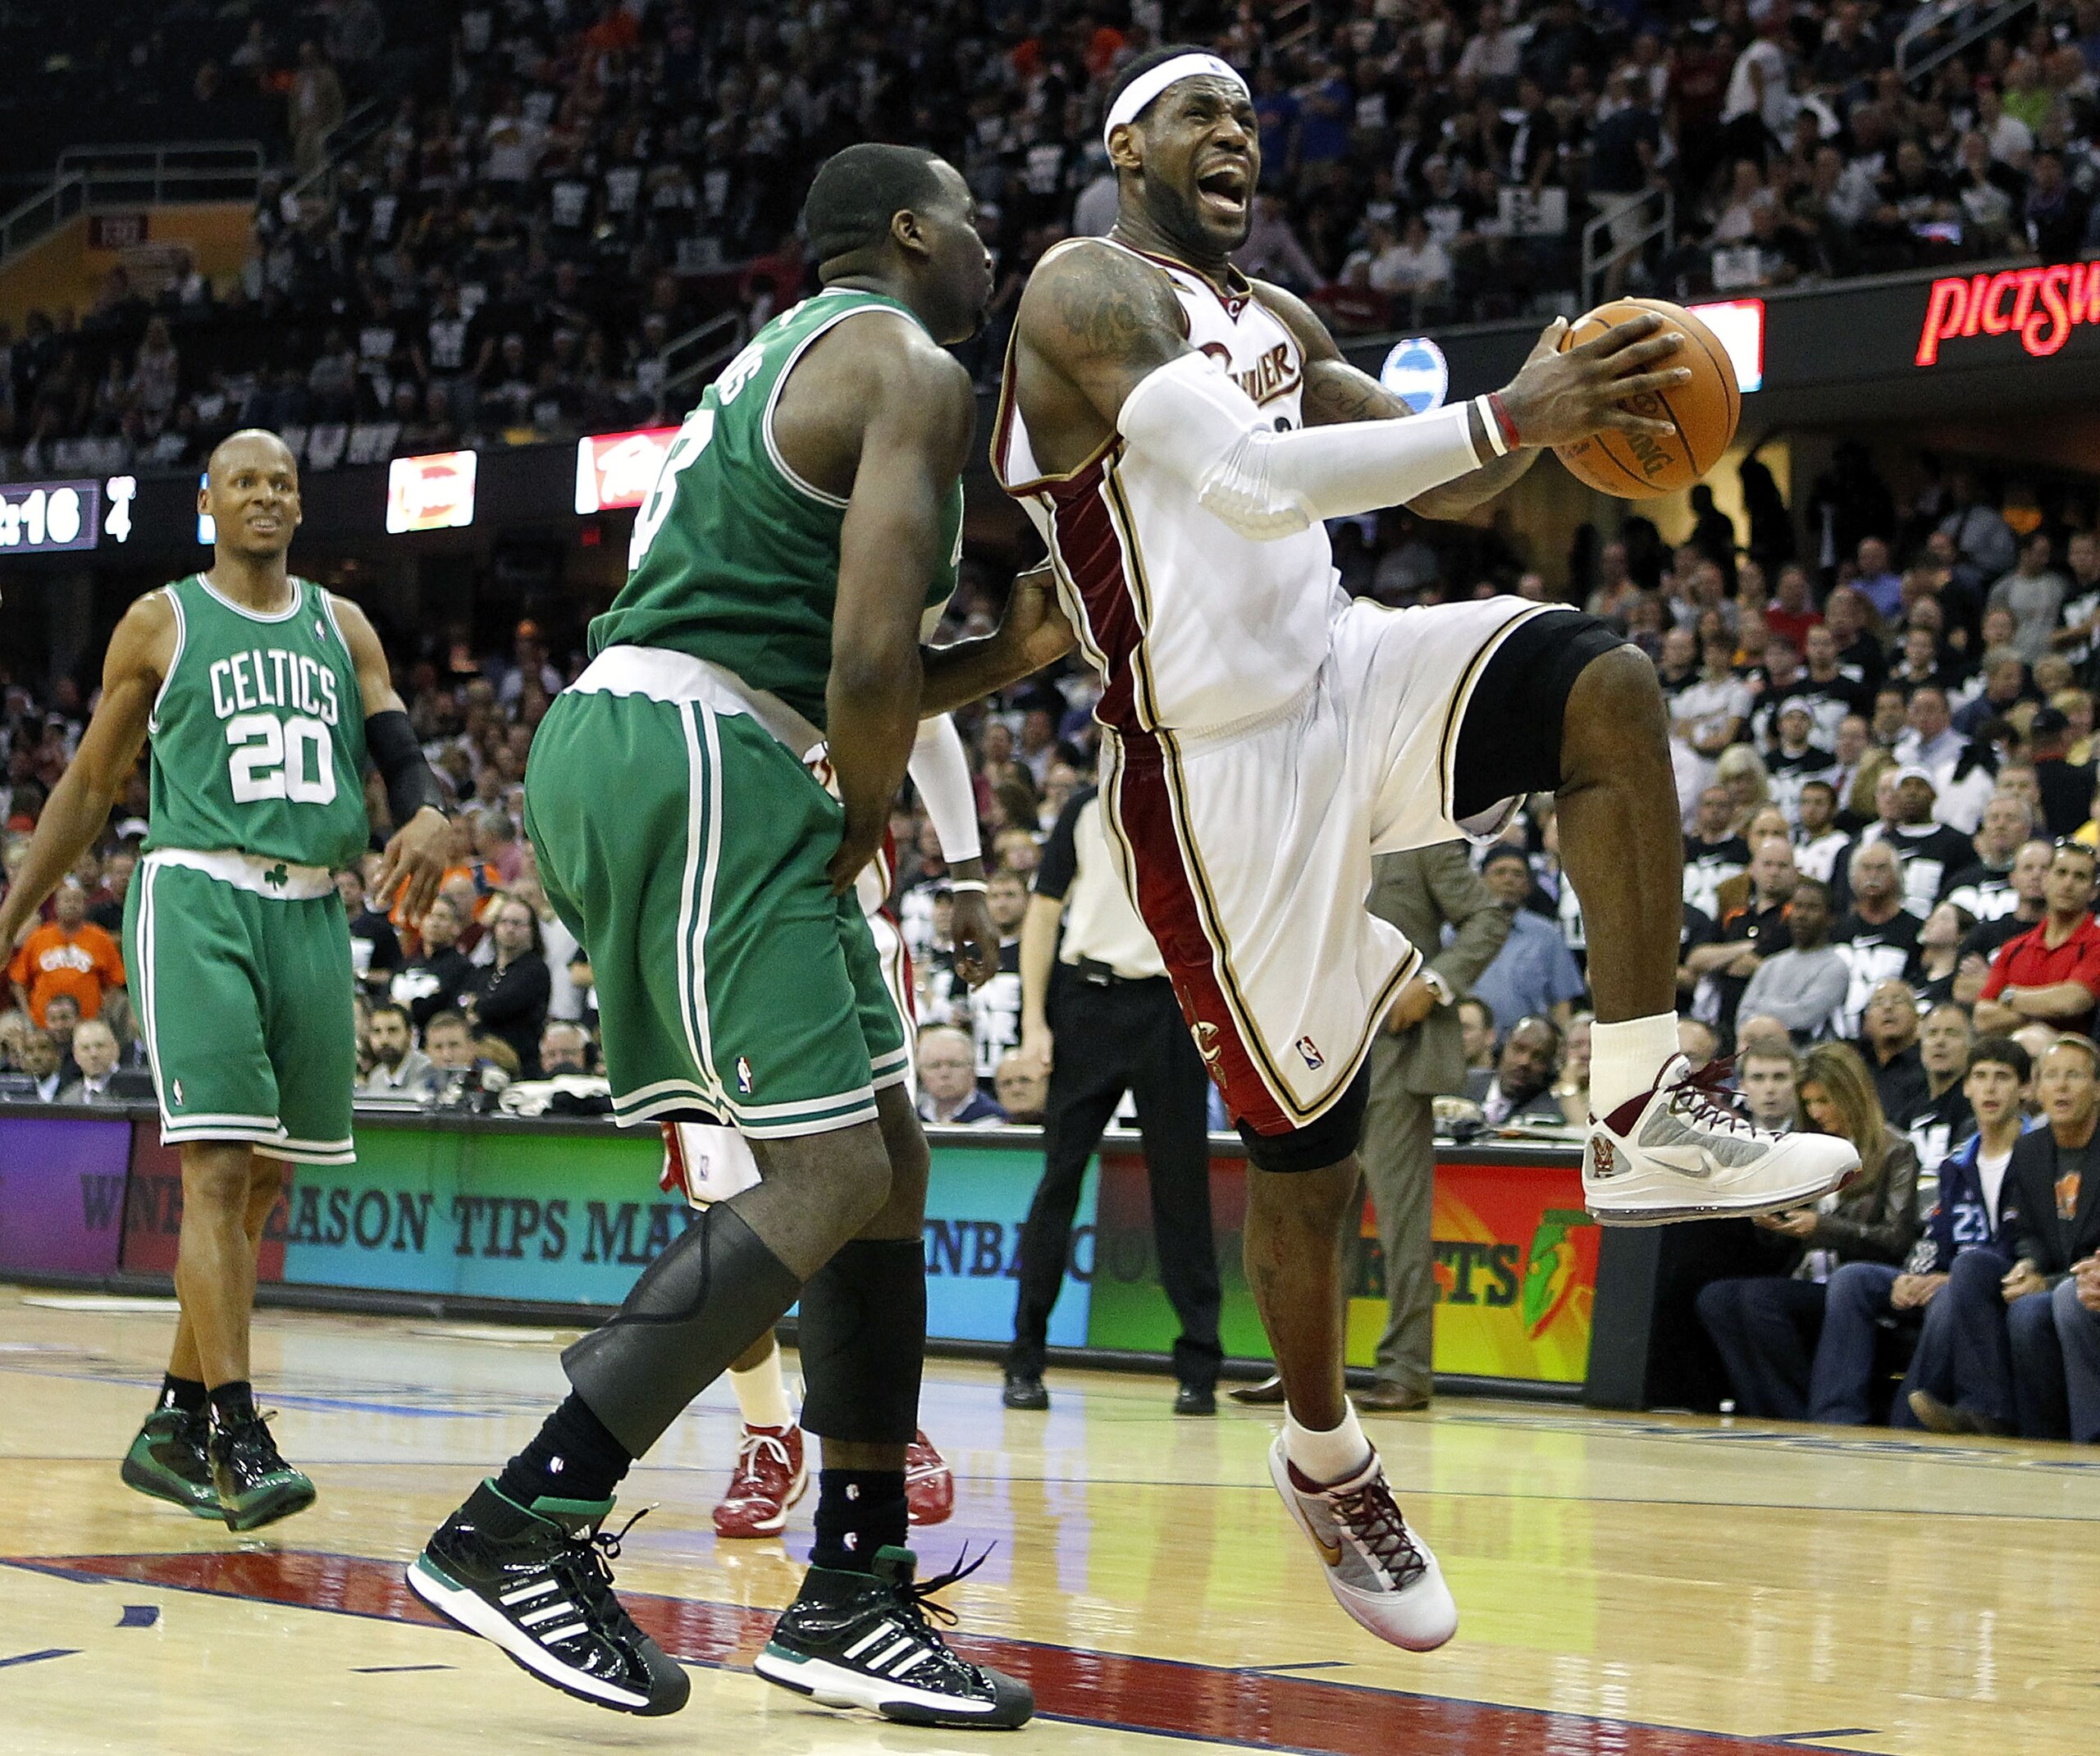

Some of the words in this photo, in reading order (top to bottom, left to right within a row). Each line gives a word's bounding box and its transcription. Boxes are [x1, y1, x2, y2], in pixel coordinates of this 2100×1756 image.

[209, 649, 338, 727] CELTICS
[226, 712, 337, 805] 20
[453, 1195, 568, 1261] TIPS
